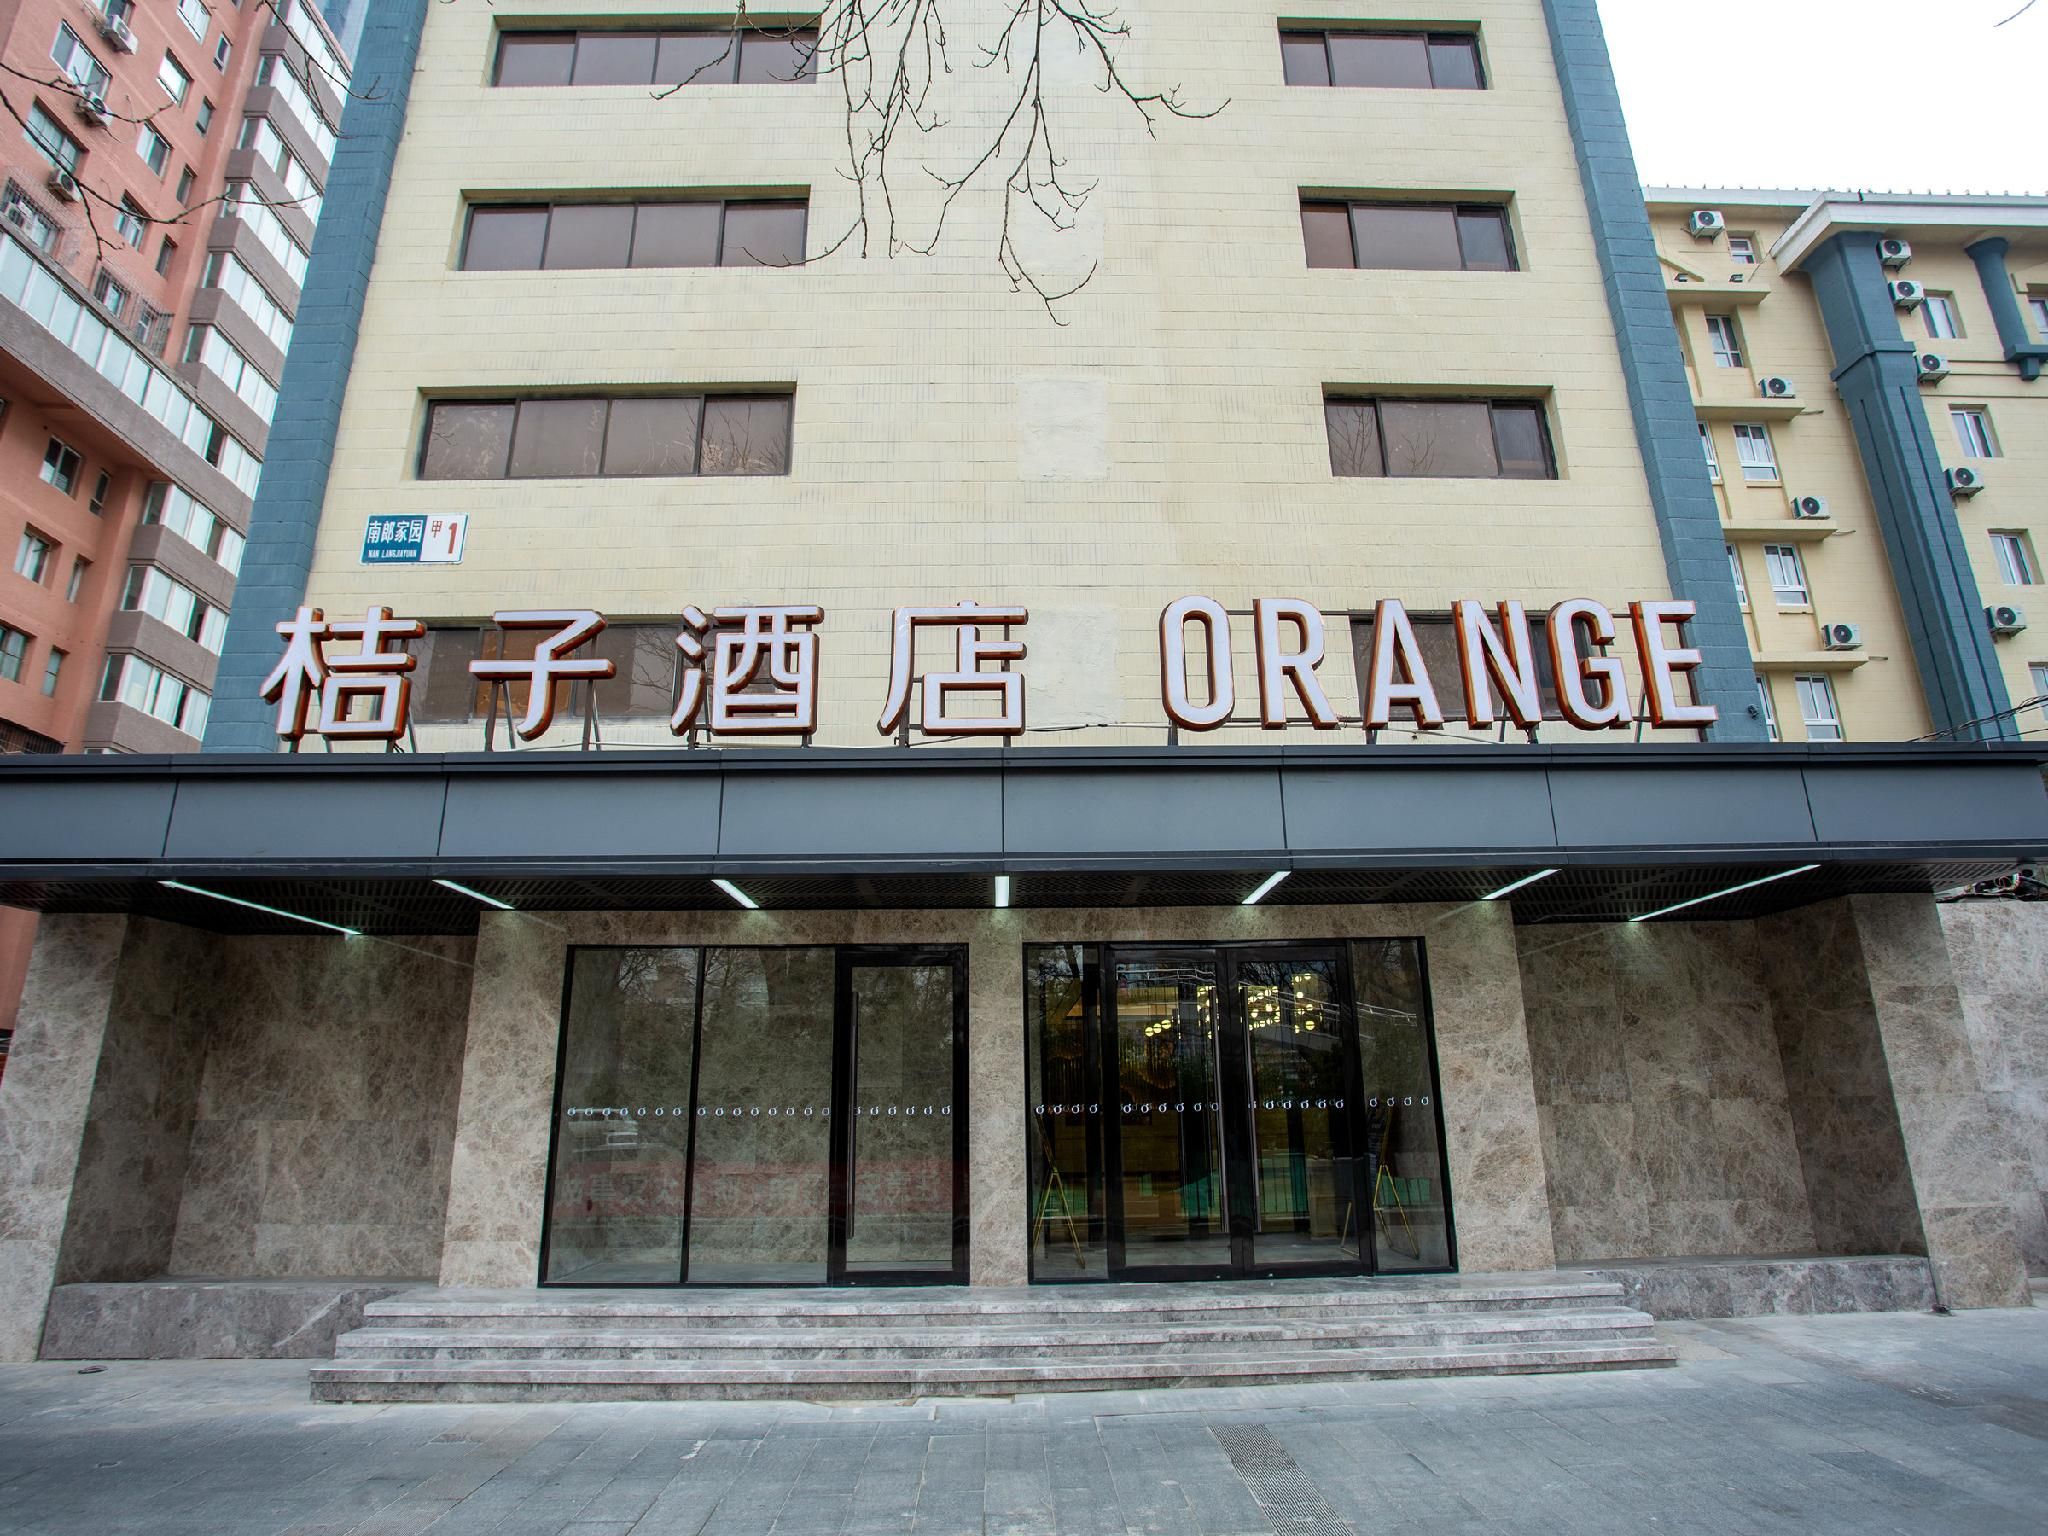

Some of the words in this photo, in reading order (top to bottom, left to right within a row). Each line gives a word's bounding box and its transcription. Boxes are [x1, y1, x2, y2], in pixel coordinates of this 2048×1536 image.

[367, 520, 423, 543] 南郎家园
[259, 602, 1028, 740] 桔子酒店
[1160, 595, 1718, 731] ORANGE
